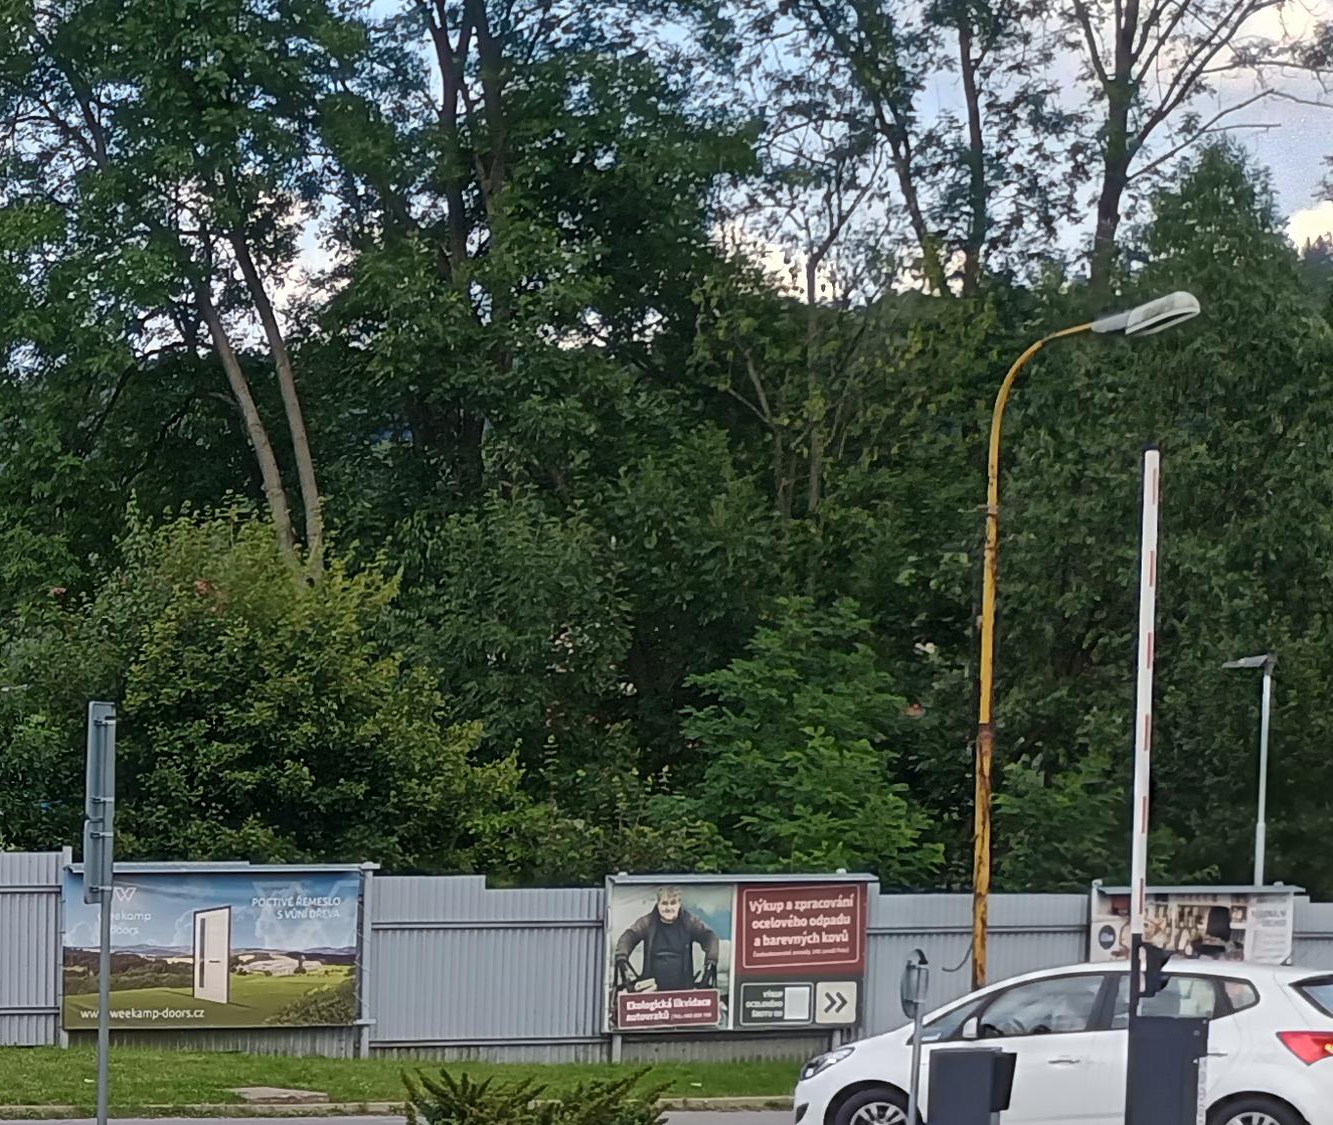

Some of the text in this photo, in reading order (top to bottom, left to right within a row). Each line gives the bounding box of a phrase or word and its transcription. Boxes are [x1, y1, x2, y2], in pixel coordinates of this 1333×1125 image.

[749, 898, 784, 914] Výkup
[786, 900, 793, 910] a
[98, 911, 151, 922] ekamp
[751, 913, 851, 929] ocelového odpadu
[753, 937, 761, 946] a
[762, 930, 820, 947] barevných
[80, 1008, 205, 1020] wwweekamp-doors.cz
